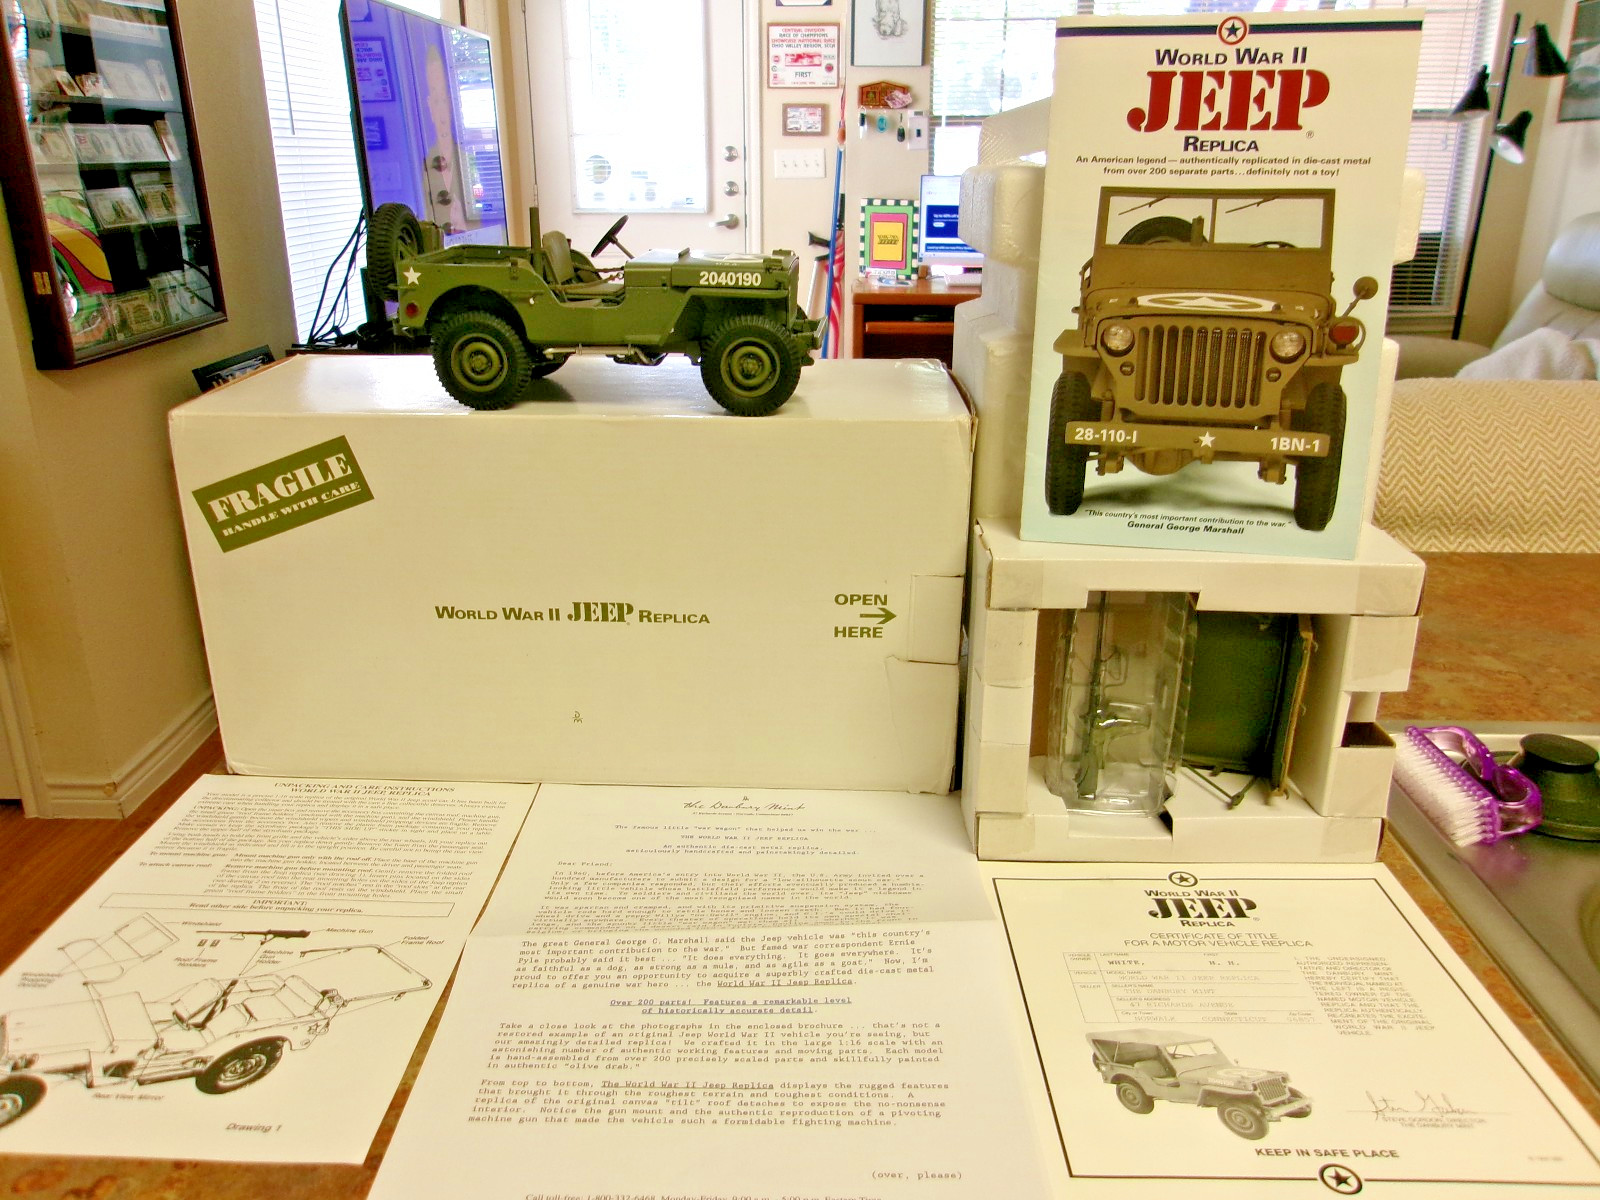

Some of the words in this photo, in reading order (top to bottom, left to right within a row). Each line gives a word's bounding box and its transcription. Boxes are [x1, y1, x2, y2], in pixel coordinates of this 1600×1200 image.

[1292, 47, 1307, 64] II
[1127, 69, 1330, 132] JEEP
[1076, 156, 1088, 164] An
[1091, 156, 1134, 164] American
[1180, 156, 1239, 165] authentically
[1242, 156, 1289, 165] replicated
[1292, 156, 1300, 164] in
[1303, 156, 1340, 165] die-cast
[1343, 157, 1371, 165] metal
[1103, 167, 1124, 175] from
[1169, 168, 1208, 177] separate
[1293, 168, 1309, 176] not
[1320, 168, 1340, 177] toy!
[700, 271, 761, 286] 2040190
[1270, 438, 1320, 452] 1BN-1
[208, 452, 352, 523] FRAGILE
[222, 511, 279, 536] HANDLE
[280, 497, 319, 515] WITH
[321, 482, 361, 503] CARE
[1127, 521, 1163, 530] General
[1167, 523, 1200, 532] George
[1203, 525, 1244, 534] Marshall
[834, 594, 887, 605] OPEN
[549, 608, 560, 621] II
[567, 602, 634, 622] JEEP
[834, 627, 883, 638] HERE
[710, 801, 760, 811] Danbury
[1148, 898, 1257, 918] JEEP
[761, 935, 782, 943] Jeep
[883, 930, 930, 938] country's
[632, 1116, 673, 1124] vehicle
[792, 1118, 841, 1127] fighting
[1254, 1148, 1292, 1157] KEEP
[1295, 1148, 1311, 1157] IN
[1313, 1148, 1350, 1158] SAFE
[1353, 1149, 1400, 1158] PLACE
[872, 1171, 909, 1180] (over,
[917, 1171, 961, 1180] please)
